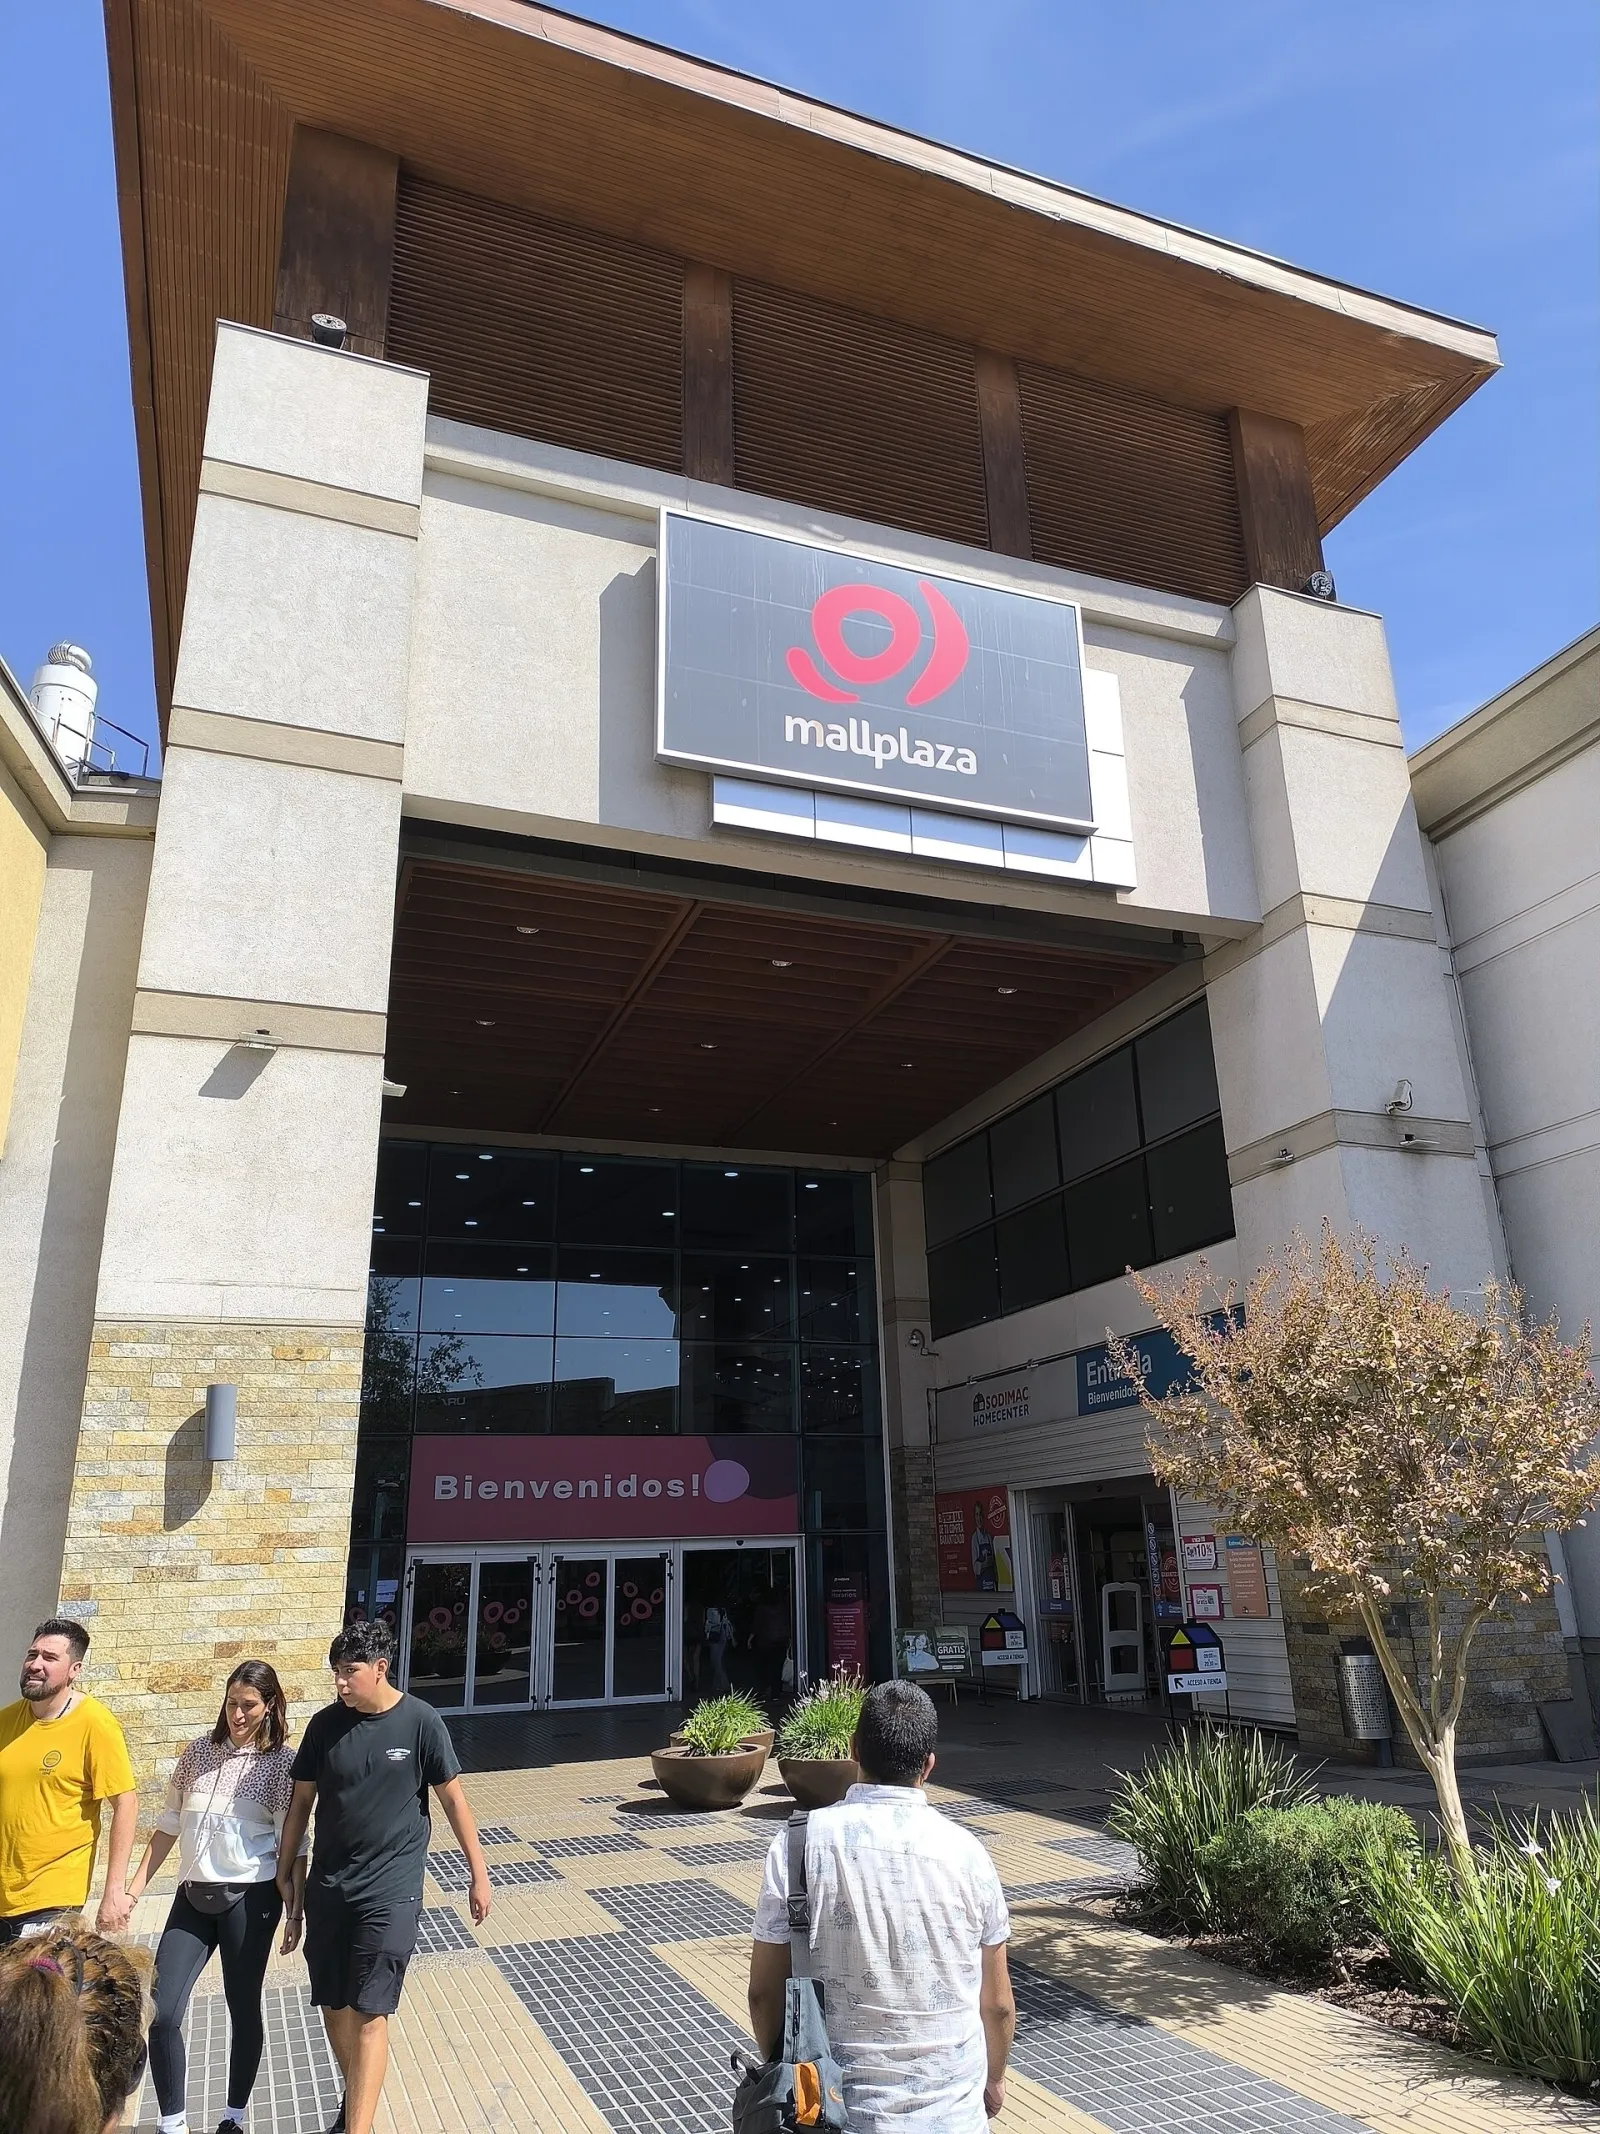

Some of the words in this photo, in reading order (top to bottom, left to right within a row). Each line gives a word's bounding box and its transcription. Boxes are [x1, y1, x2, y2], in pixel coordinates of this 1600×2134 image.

[785, 715, 978, 775] mallplaza
[986, 1386, 1029, 1410] SODIMAC
[1088, 1385, 1138, 1405] Bienvenidos
[973, 1404, 1030, 1427] HOMECENTER
[434, 1473, 700, 1500] Bienvenidos!
[937, 1645, 966, 1654] GRATIS
